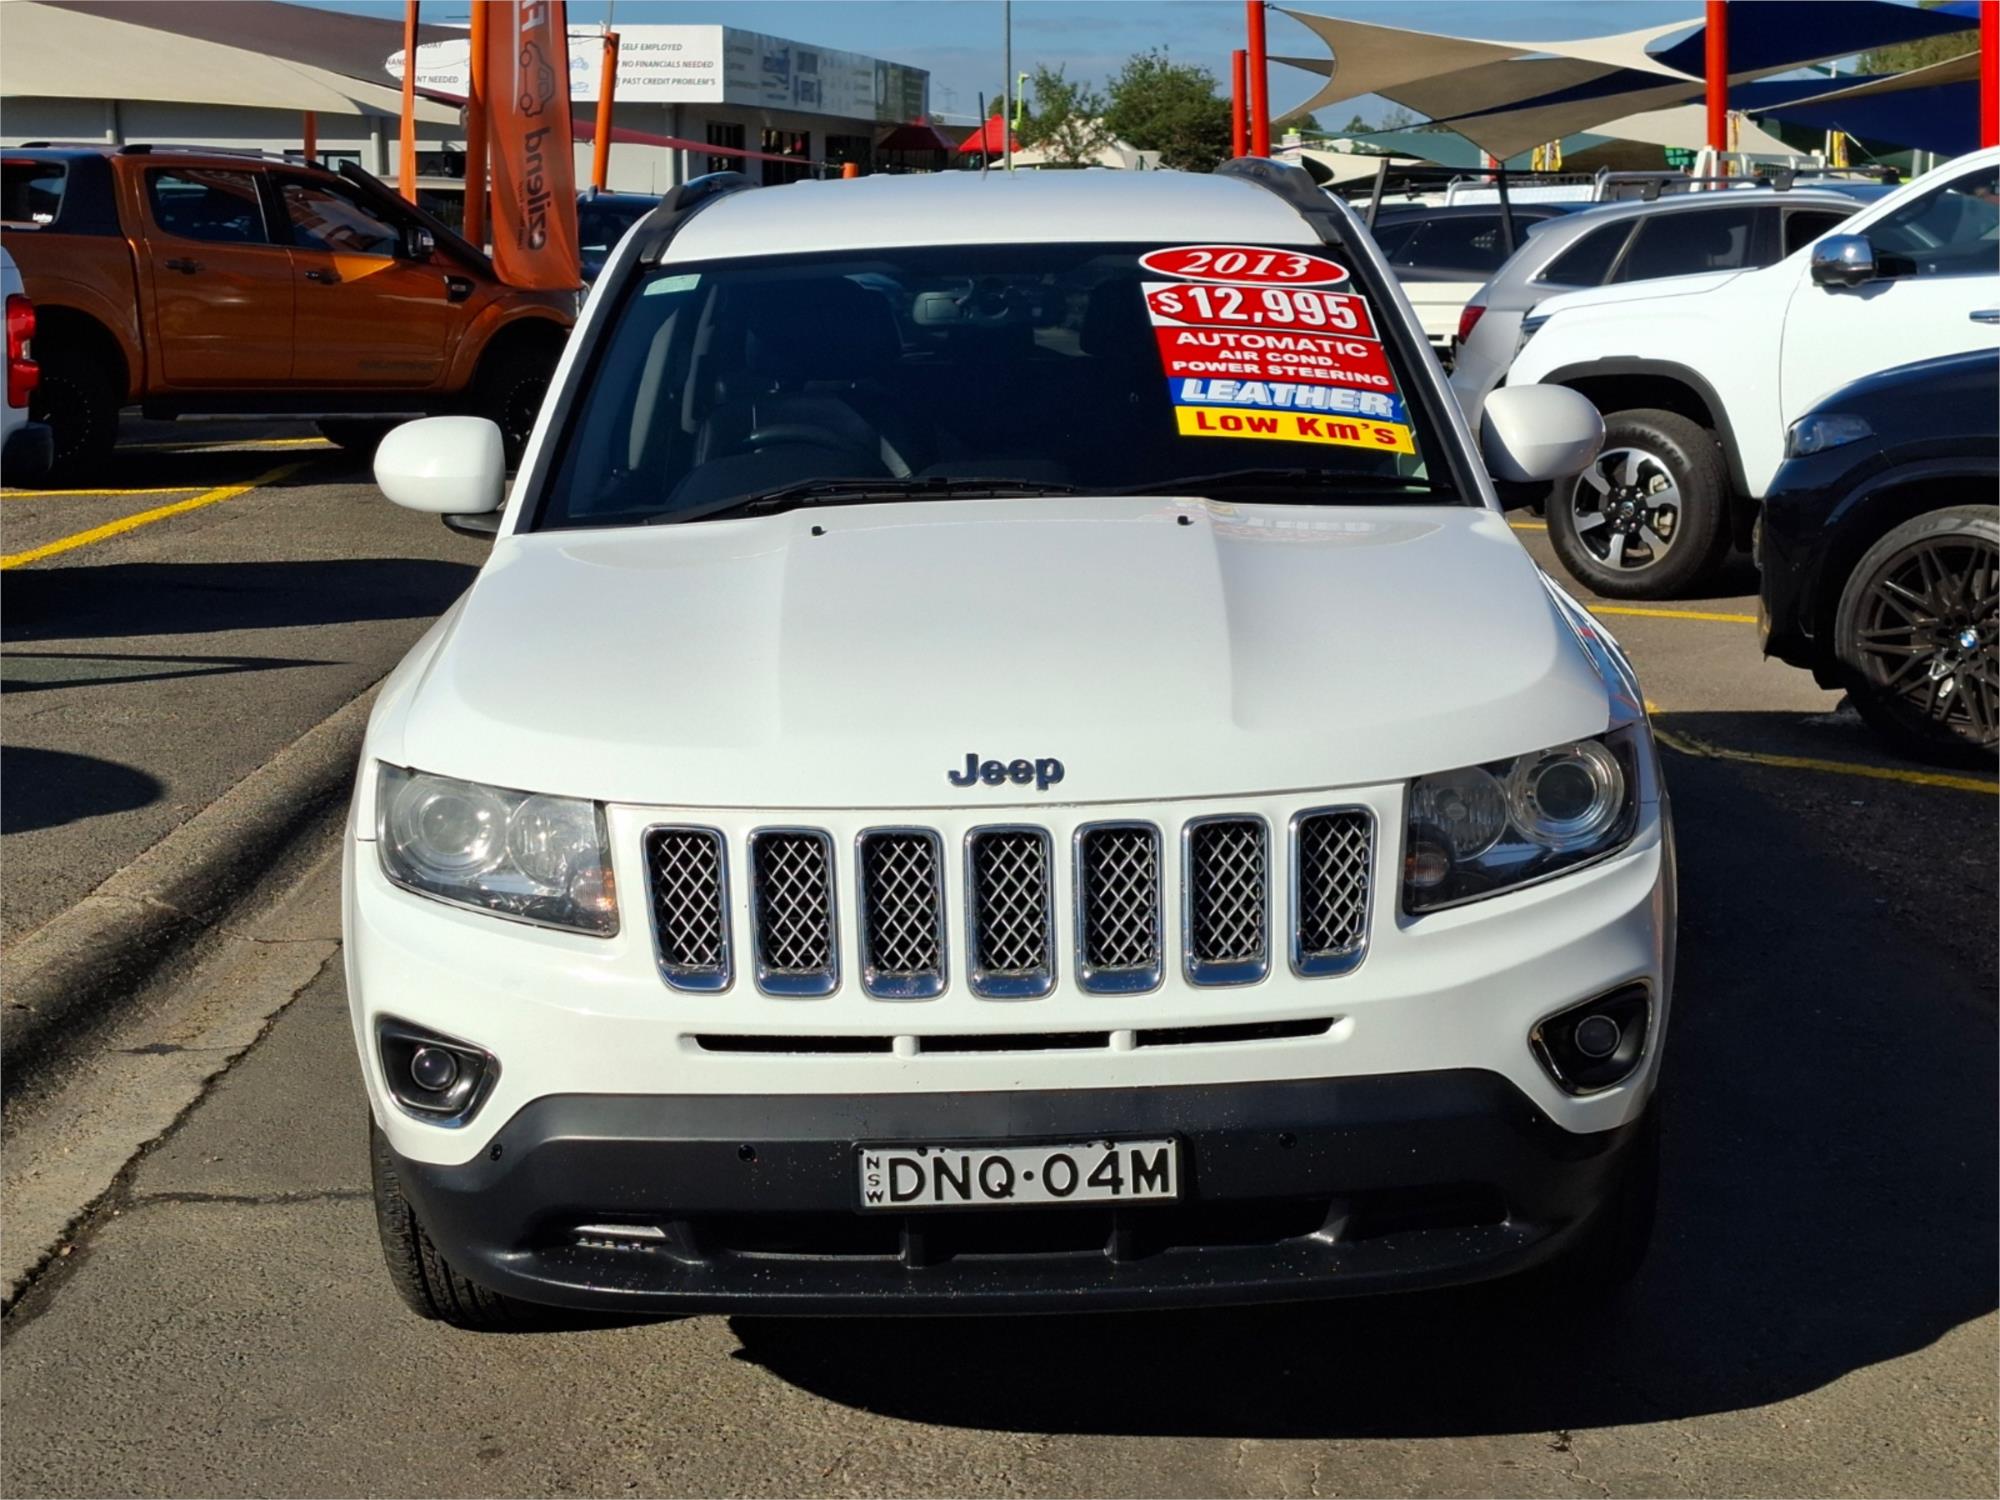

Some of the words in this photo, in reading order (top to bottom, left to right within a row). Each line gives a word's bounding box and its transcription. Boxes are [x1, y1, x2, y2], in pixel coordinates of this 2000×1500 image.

[621, 43, 639, 51] SELF
[640, 43, 683, 51] EMPLOYED
[622, 78, 640, 86] PAST
[642, 78, 671, 86] CREDIT
[1177, 251, 1310, 278] 2013
[1156, 287, 1358, 329] $12,995
[1176, 332, 1368, 357] AUTOMATIC
[1218, 350, 1260, 361] AIR
[1266, 352, 1340, 367] COND.
[1172, 361, 1261, 374] POWER
[1267, 366, 1389, 386] STEERING
[1180, 378, 1393, 418] LEATHER
[1296, 417, 1397, 445] Km's
[948, 753, 1065, 790] Jeep
